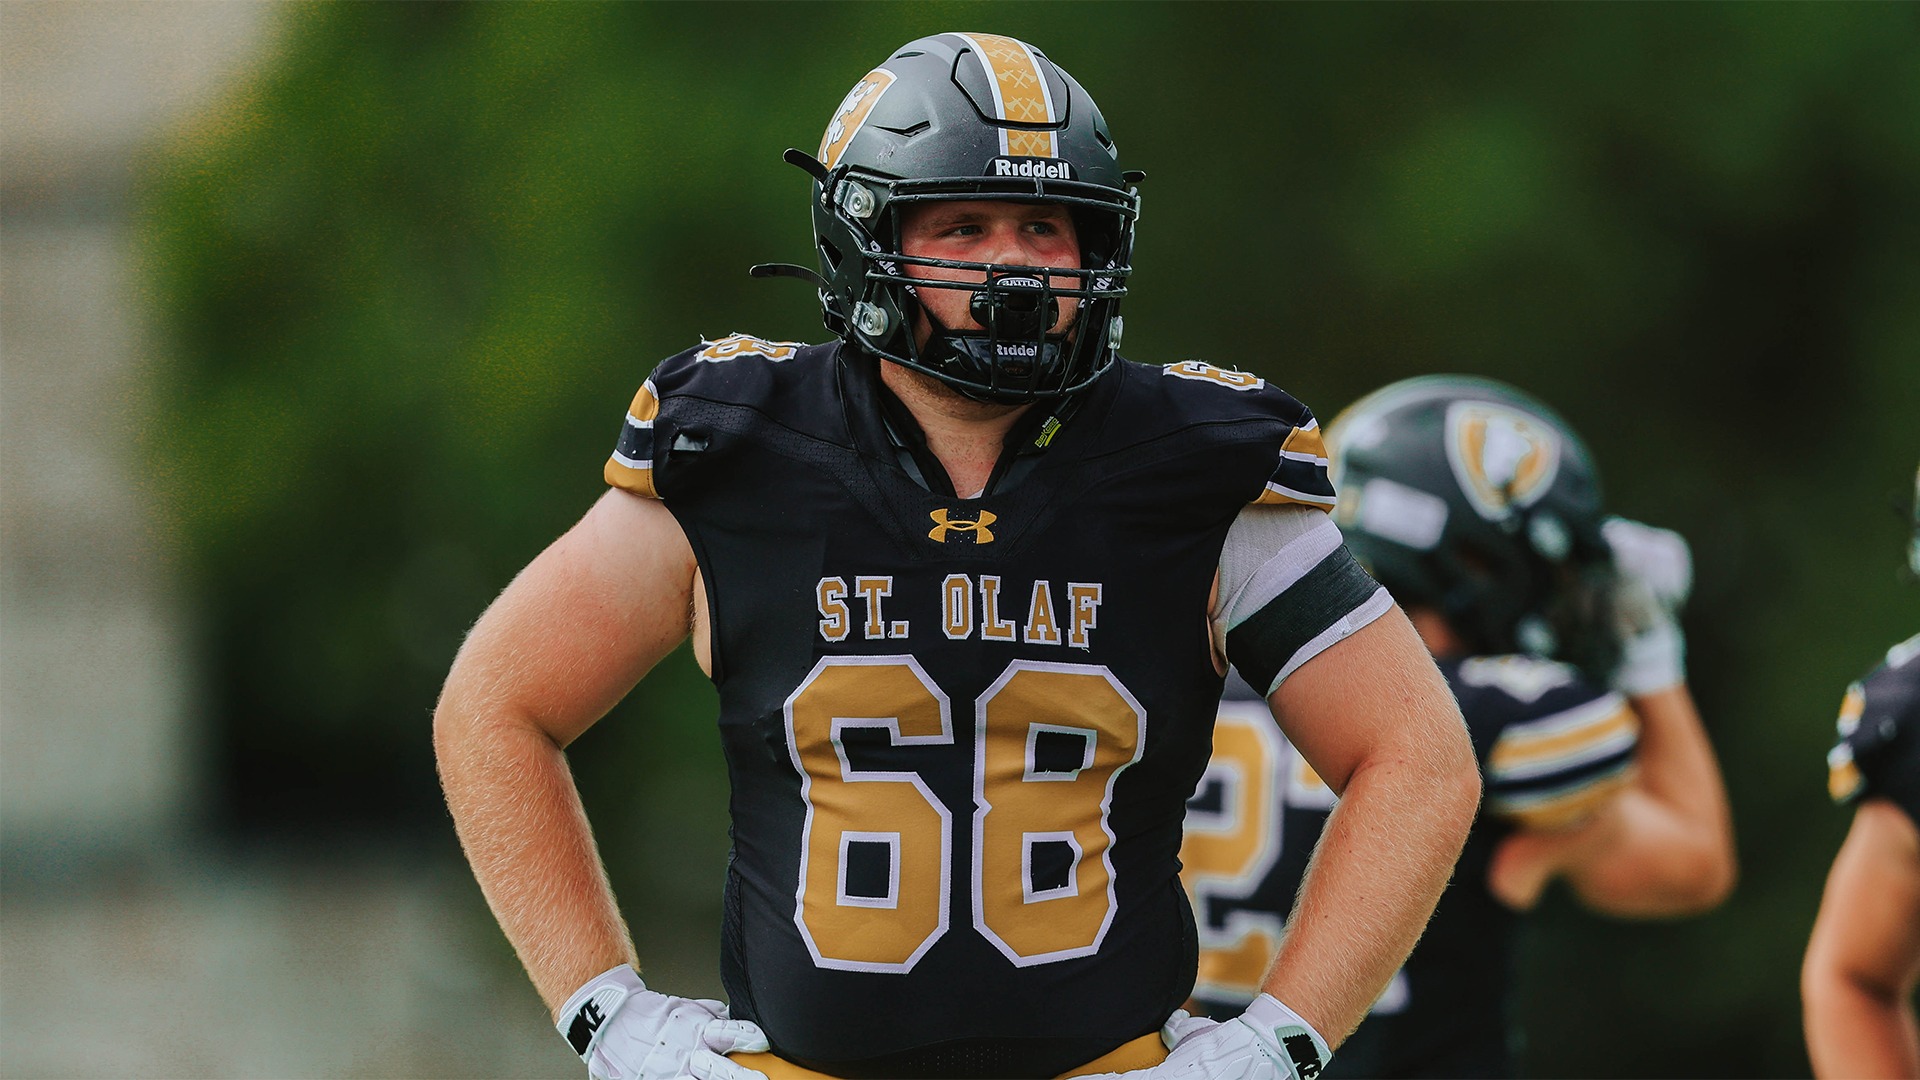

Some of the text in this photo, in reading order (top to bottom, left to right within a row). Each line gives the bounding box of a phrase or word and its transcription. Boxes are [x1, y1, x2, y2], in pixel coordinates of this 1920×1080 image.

[995, 159, 1070, 179] Riddell
[996, 343, 1038, 357] Riddel
[816, 573, 1102, 648] ST. OLAF
[783, 654, 1147, 975] 68
